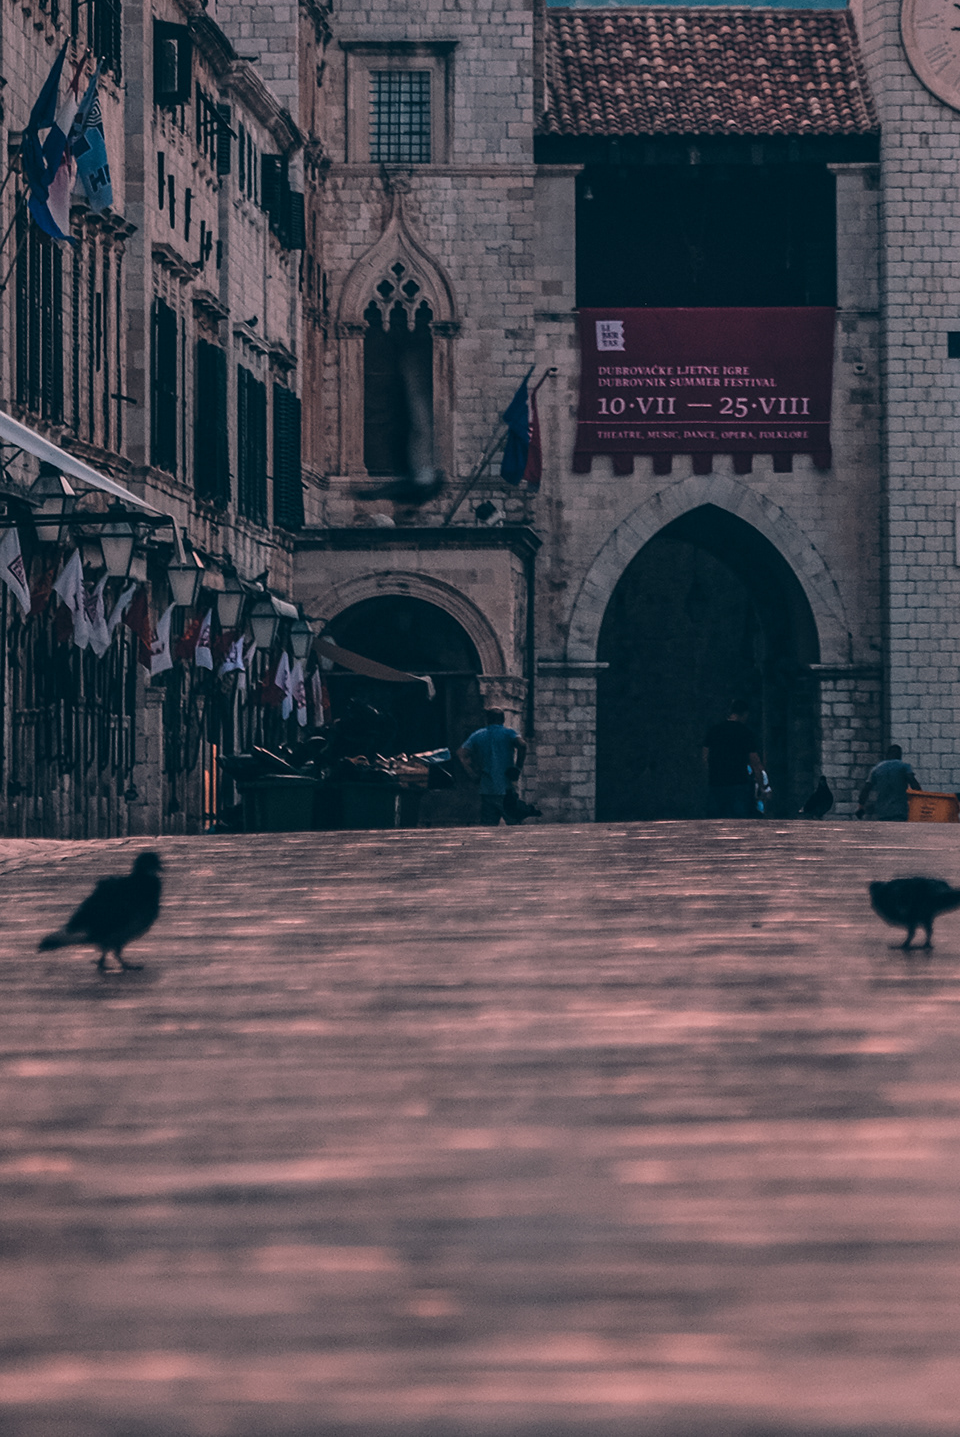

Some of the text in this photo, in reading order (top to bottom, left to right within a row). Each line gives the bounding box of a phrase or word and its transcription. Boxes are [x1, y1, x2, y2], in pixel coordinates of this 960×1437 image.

[598, 364, 750, 376] DUBROVAČKE LJETNE IGRE
[598, 377, 778, 388] DUBROVNIK SUMMER FESTIVAL
[597, 430, 645, 440] THEATRE,
[647, 430, 681, 440] MUSIC,
[683, 430, 719, 440] DANCE,
[759, 430, 810, 439] FOLKLORE
